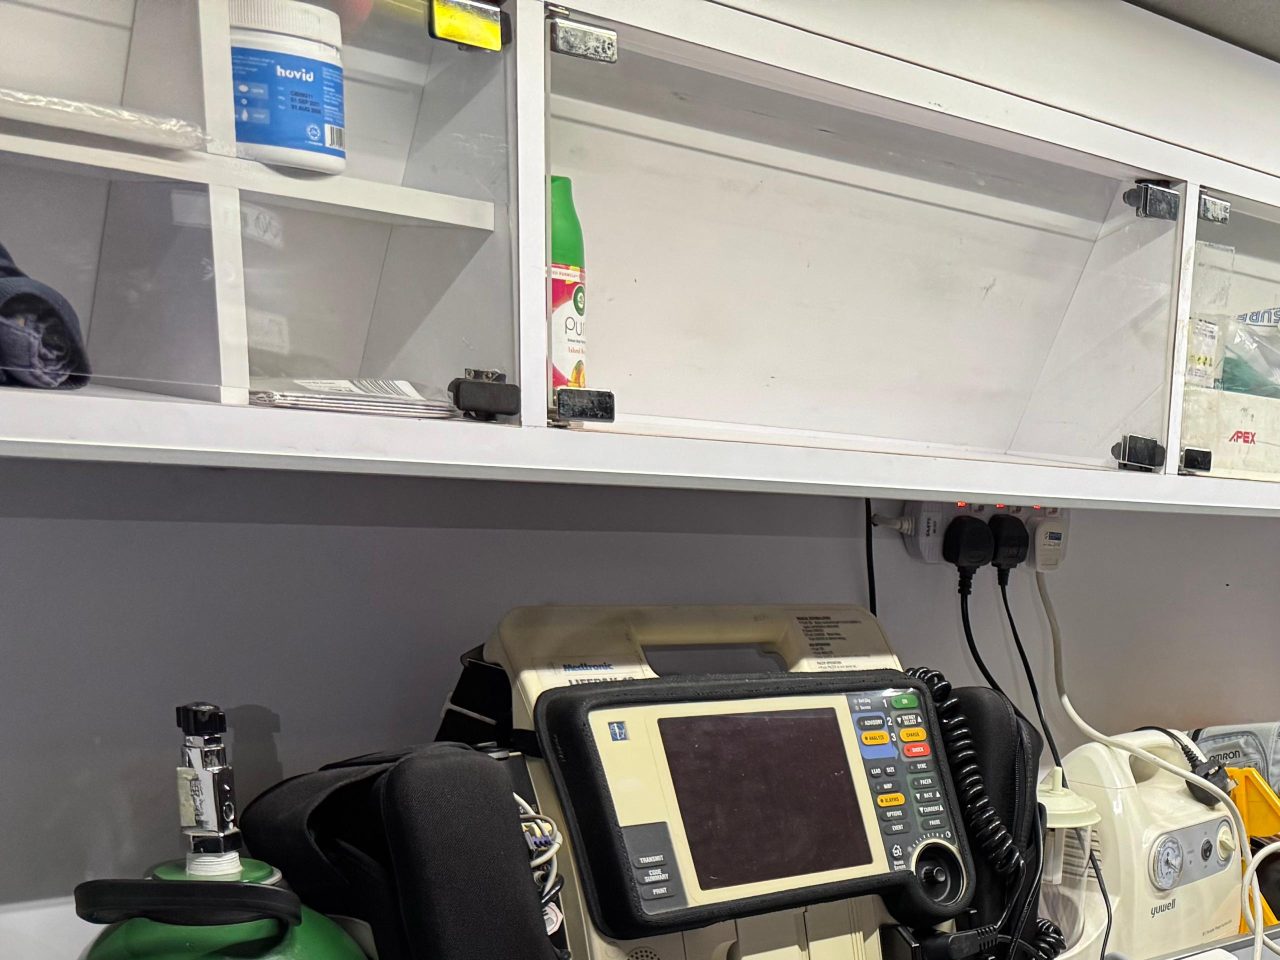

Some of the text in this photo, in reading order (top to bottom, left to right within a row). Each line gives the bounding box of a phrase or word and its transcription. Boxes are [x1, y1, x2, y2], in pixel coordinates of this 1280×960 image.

[276, 65, 314, 82] hovid
[1229, 430, 1256, 445] APEX
[563, 662, 613, 671] Medtronic
[883, 699, 888, 708] 1
[887, 717, 893, 726] 2
[890, 733, 897, 742] 3
[1210, 750, 1241, 761] OMRON
[639, 854, 664, 864] TRANSMIT
[648, 868, 662, 876] CODE
[643, 873, 669, 882] SUMMARY
[652, 887, 667, 895] PRINT
[1150, 898, 1176, 918] yuwell
